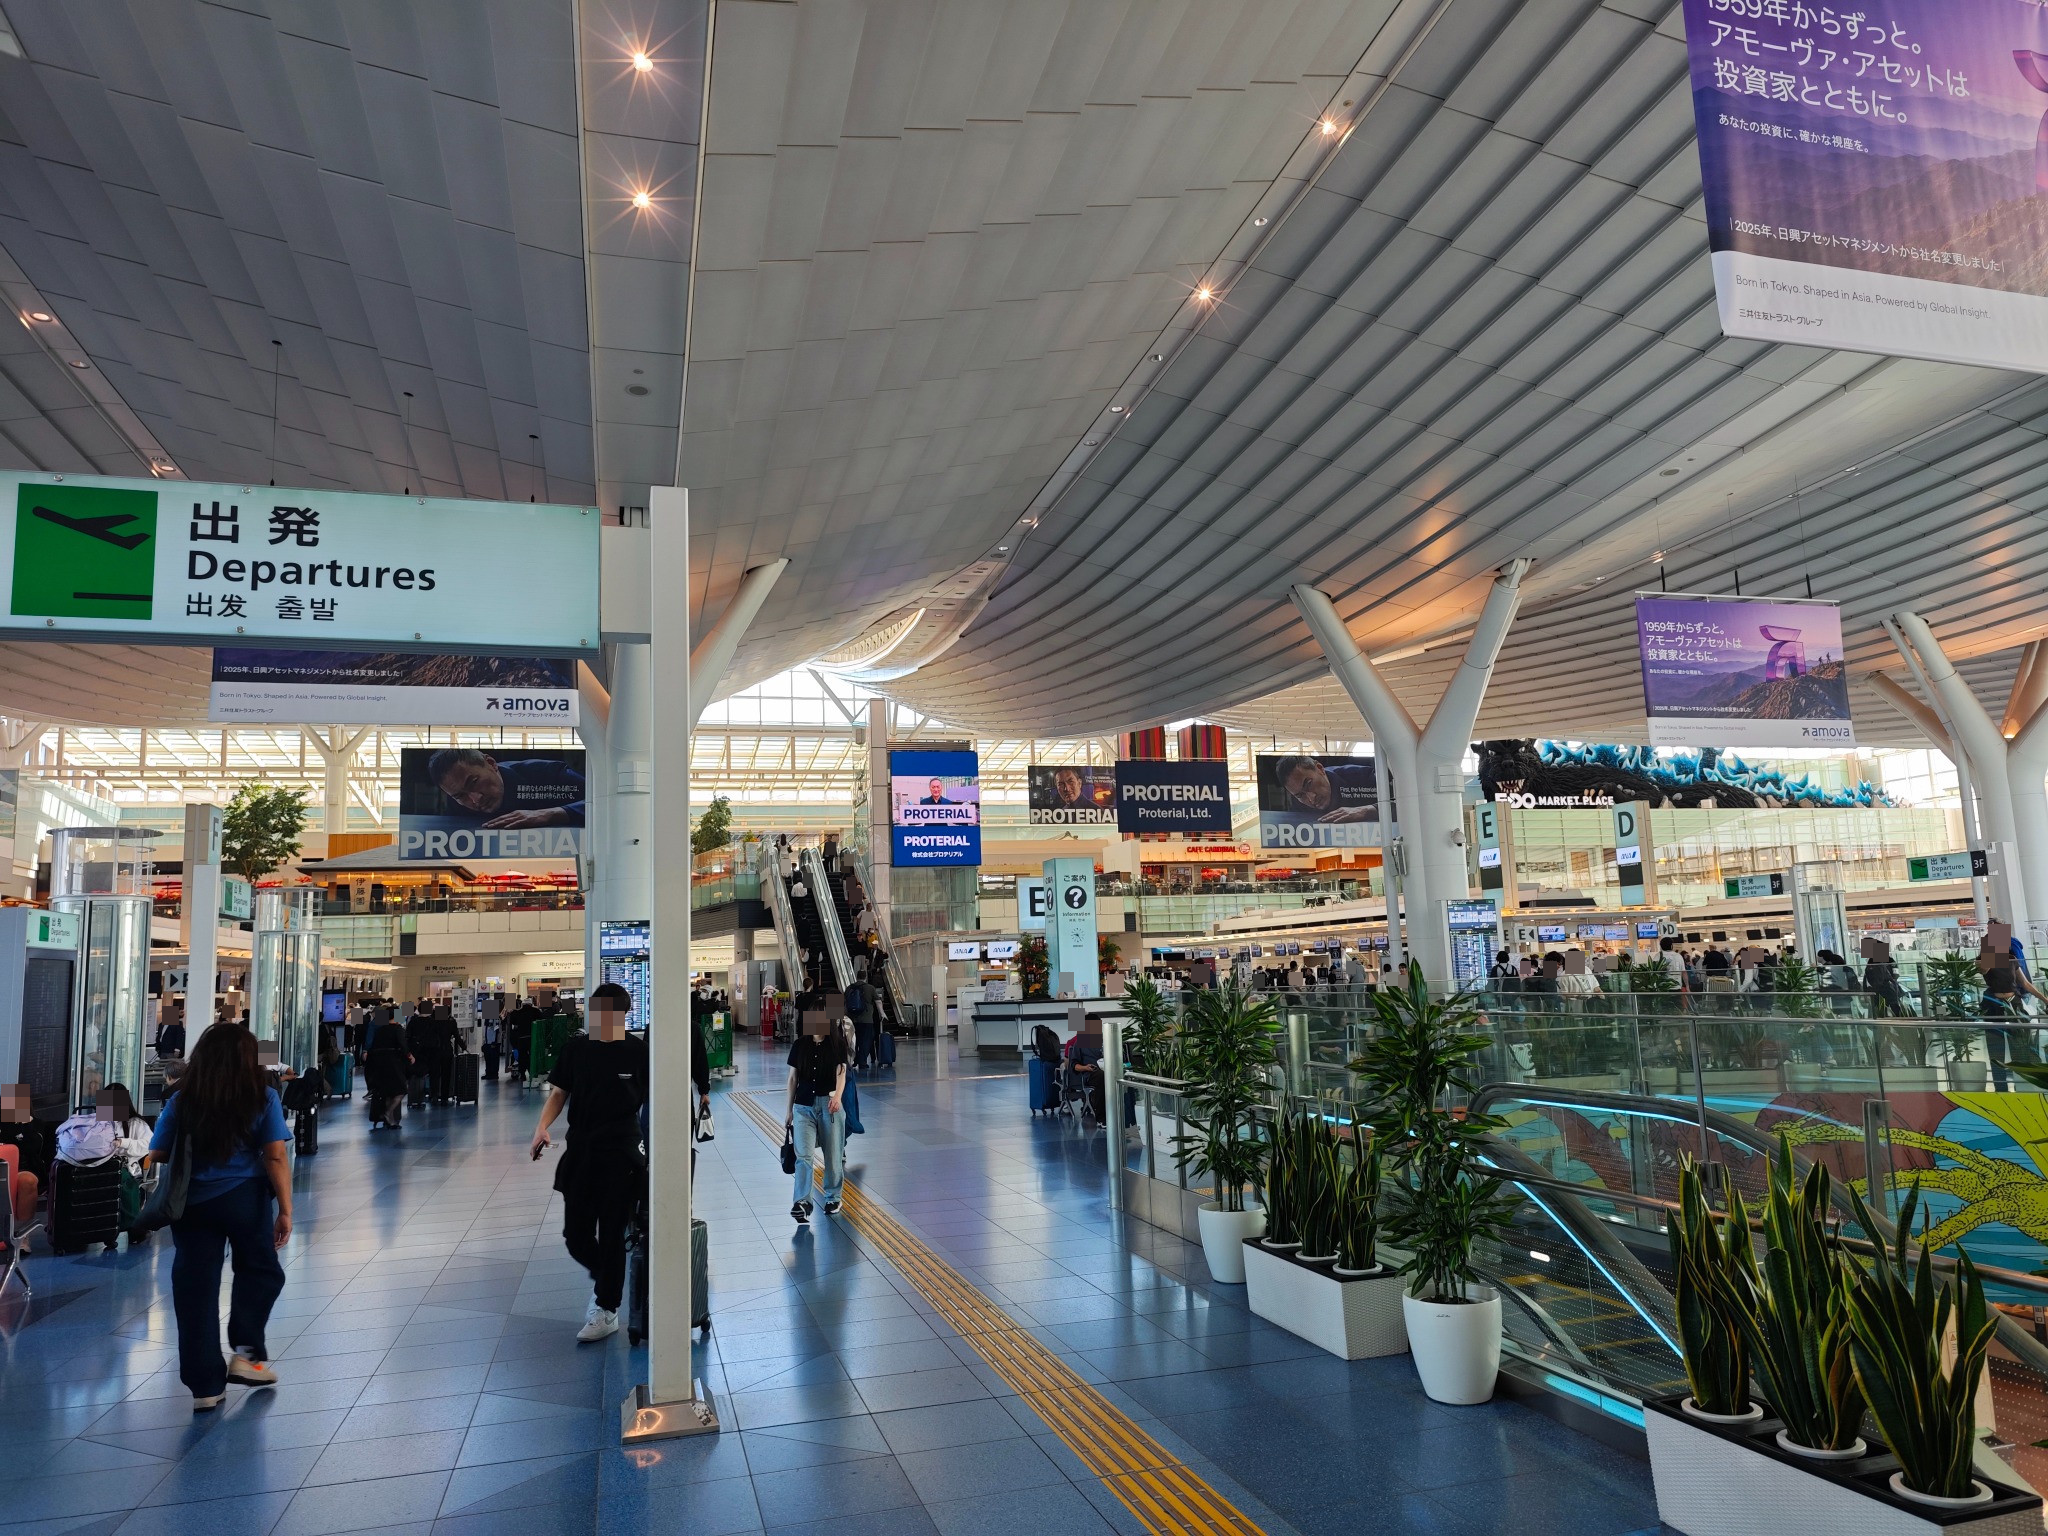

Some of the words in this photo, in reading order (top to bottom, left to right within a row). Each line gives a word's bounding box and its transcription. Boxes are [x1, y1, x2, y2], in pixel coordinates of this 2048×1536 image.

[1708, 20, 1970, 97] アモーヴァ・アセットは
[1713, 57, 1907, 123] 投資家とともに。
[1718, 113, 1869, 153] あなたの投資に、確かな視座を。
[1736, 274, 1758, 288] Born
[1760, 279, 1768, 289] in
[1770, 280, 1802, 294] Tokyo.
[1804, 284, 1839, 298] Shaped
[1841, 290, 1850, 300] in
[1852, 292, 1874, 303] Asia.
[1875, 294, 1915, 308] Powered
[1916, 300, 1928, 312] by
[1930, 302, 1958, 314] Global
[1960, 306, 1991, 320] Insight.
[1739, 308, 1824, 327] 三井住友トラストグループ
[190, 501, 320, 547] 出発
[187, 550, 436, 591] Departures
[186, 592, 248, 618] 出发
[274, 595, 338, 622] 출발
[1644, 620, 1724, 634] 1959年からずっと。
[1646, 635, 1742, 648] アモーヴァ・アセットは
[1648, 648, 1718, 662] 投資家とともに。
[503, 698, 569, 711] amova
[1812, 728, 1850, 736] amova
[1123, 784, 1223, 802] PROTERIAL
[1538, 796, 1580, 806] MARKET
[1582, 796, 1614, 806] PLACE
[904, 809, 972, 819] PROTERIAL
[1030, 808, 1118, 824] PROTERIA
[1138, 808, 1189, 819] Proterial,
[1190, 809, 1212, 818] Ltd.
[1482, 811, 1493, 838] E
[1618, 811, 1634, 837] D
[213, 817, 219, 851] F
[904, 836, 970, 846] PROTERIAL
[1262, 823, 1382, 847] PROTERIA
[400, 829, 585, 858] PROTERIA
[1932, 864, 1965, 872] Departures
[1974, 859, 1984, 869] 3F
[1772, 880, 1780, 888] 3F
[1504, 930, 1509, 940] E
[1519, 929, 1526, 940] E
[1667, 924, 1674, 934] D
